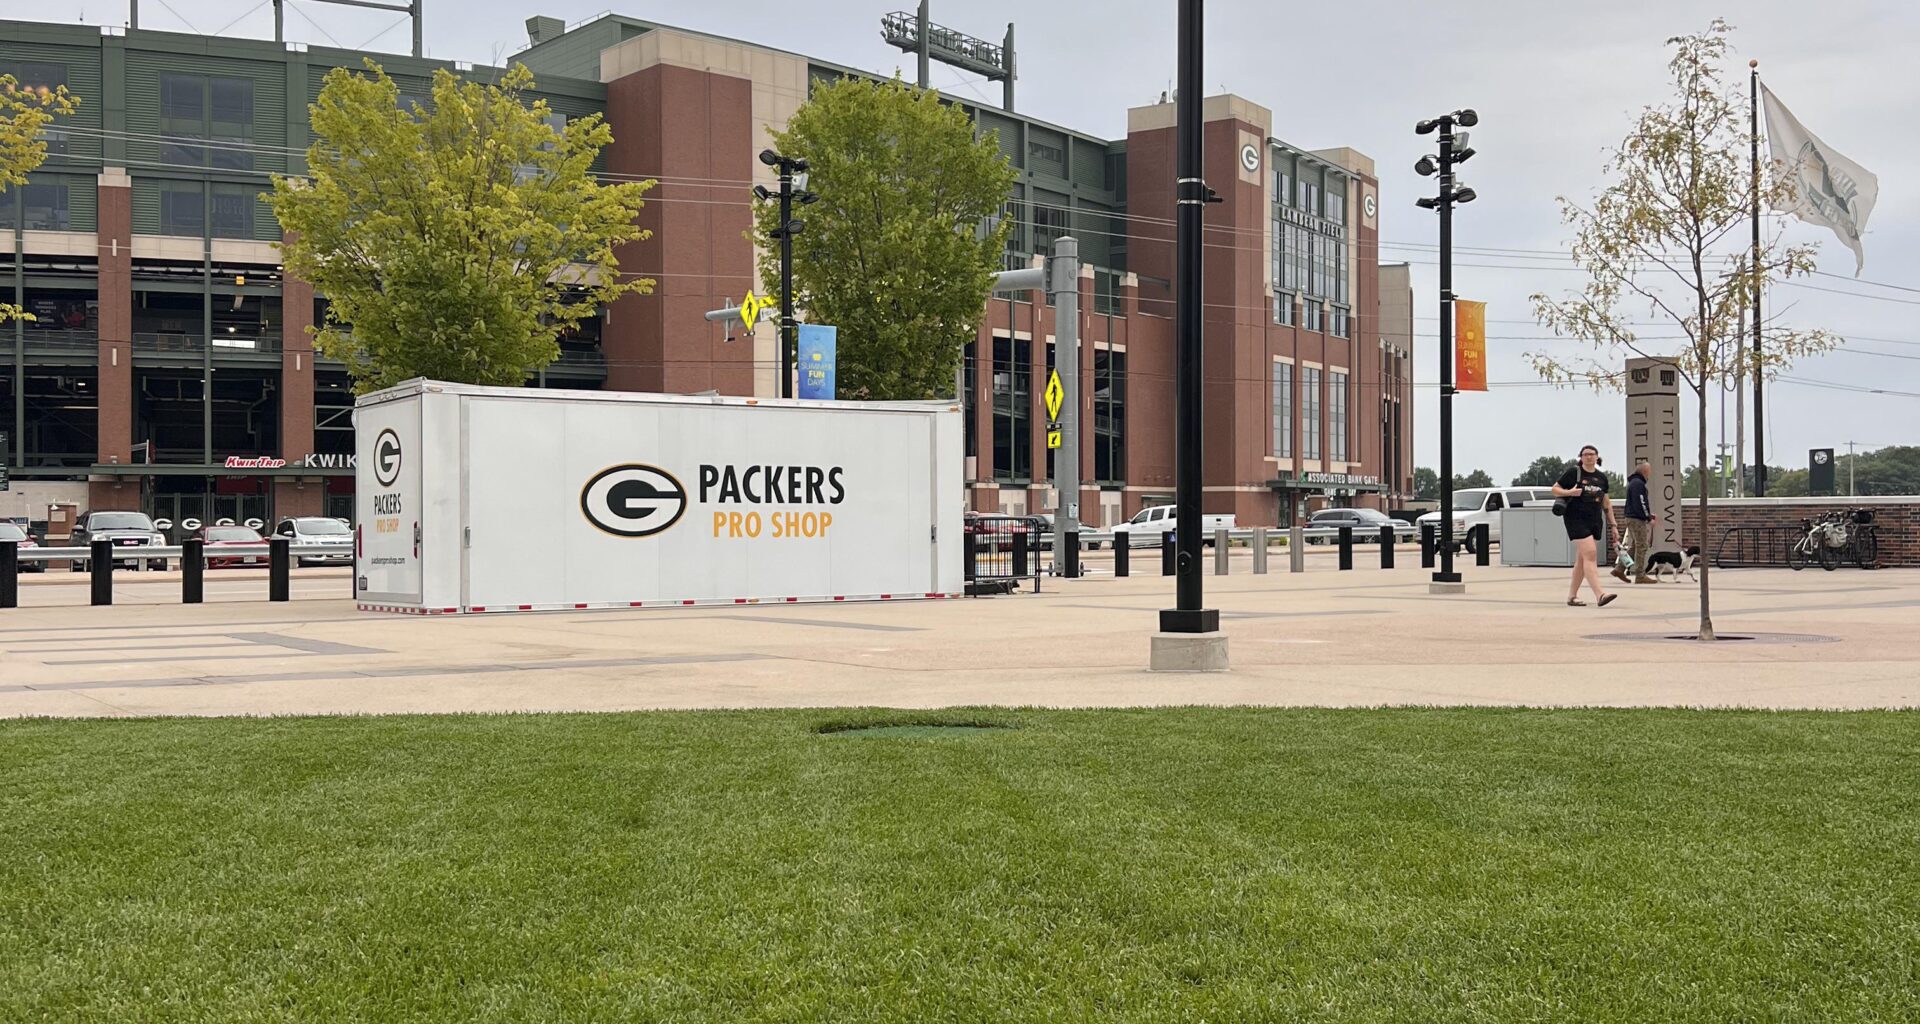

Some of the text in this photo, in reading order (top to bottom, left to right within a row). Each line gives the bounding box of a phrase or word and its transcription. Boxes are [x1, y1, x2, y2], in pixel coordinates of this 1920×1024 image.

[1241, 144, 1259, 172] G
[1281, 206, 1344, 239] LAMBEAU FIELD
[1463, 350, 1478, 359] FUN
[807, 378, 825, 386] DAYS
[808, 370, 825, 378] FUN
[1634, 407, 1648, 466] TITLE
[225, 456, 286, 468] KWIK TRIP
[304, 454, 357, 468] KWIK
[1308, 472, 1378, 485] ASSOCIATED BANK GATE
[1662, 406, 1676, 542] TITLETOWN
[699, 464, 845, 504] PACKERS
[374, 493, 401, 515] PACKERS
[583, 464, 686, 536] G
[182, 518, 202, 530] G
[244, 518, 264, 530] G
[376, 518, 399, 534] PRO SHOP
[713, 511, 833, 538] PRO SHOP
